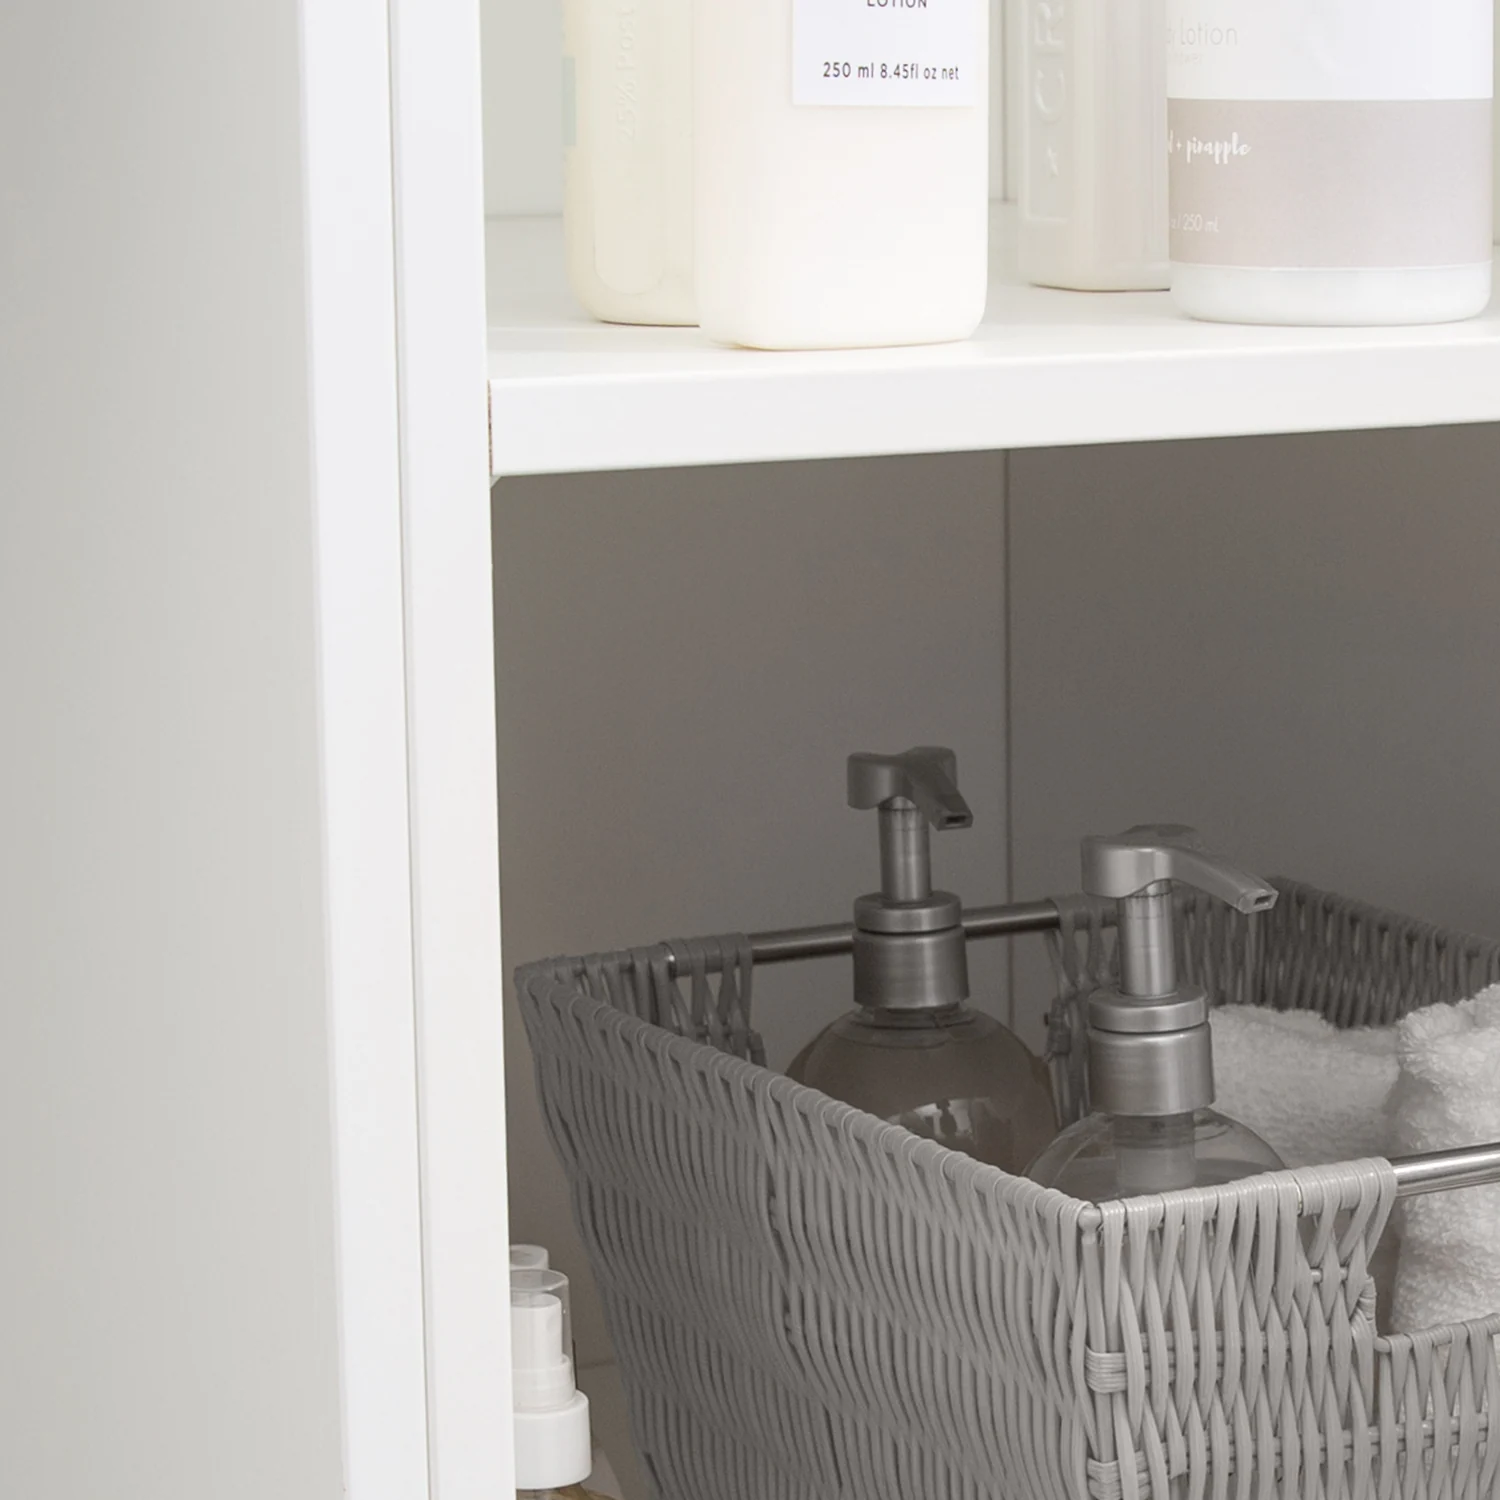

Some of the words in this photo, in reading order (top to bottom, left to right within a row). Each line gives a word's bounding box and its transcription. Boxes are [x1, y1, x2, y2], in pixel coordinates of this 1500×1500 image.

[1181, 16, 1238, 46] lotion
[822, 60, 852, 79] 250
[857, 61, 875, 79] ml
[879, 62, 919, 81] 8.45fl
[923, 66, 937, 81] oz
[941, 64, 960, 81] net
[1182, 212, 1203, 232] 250
